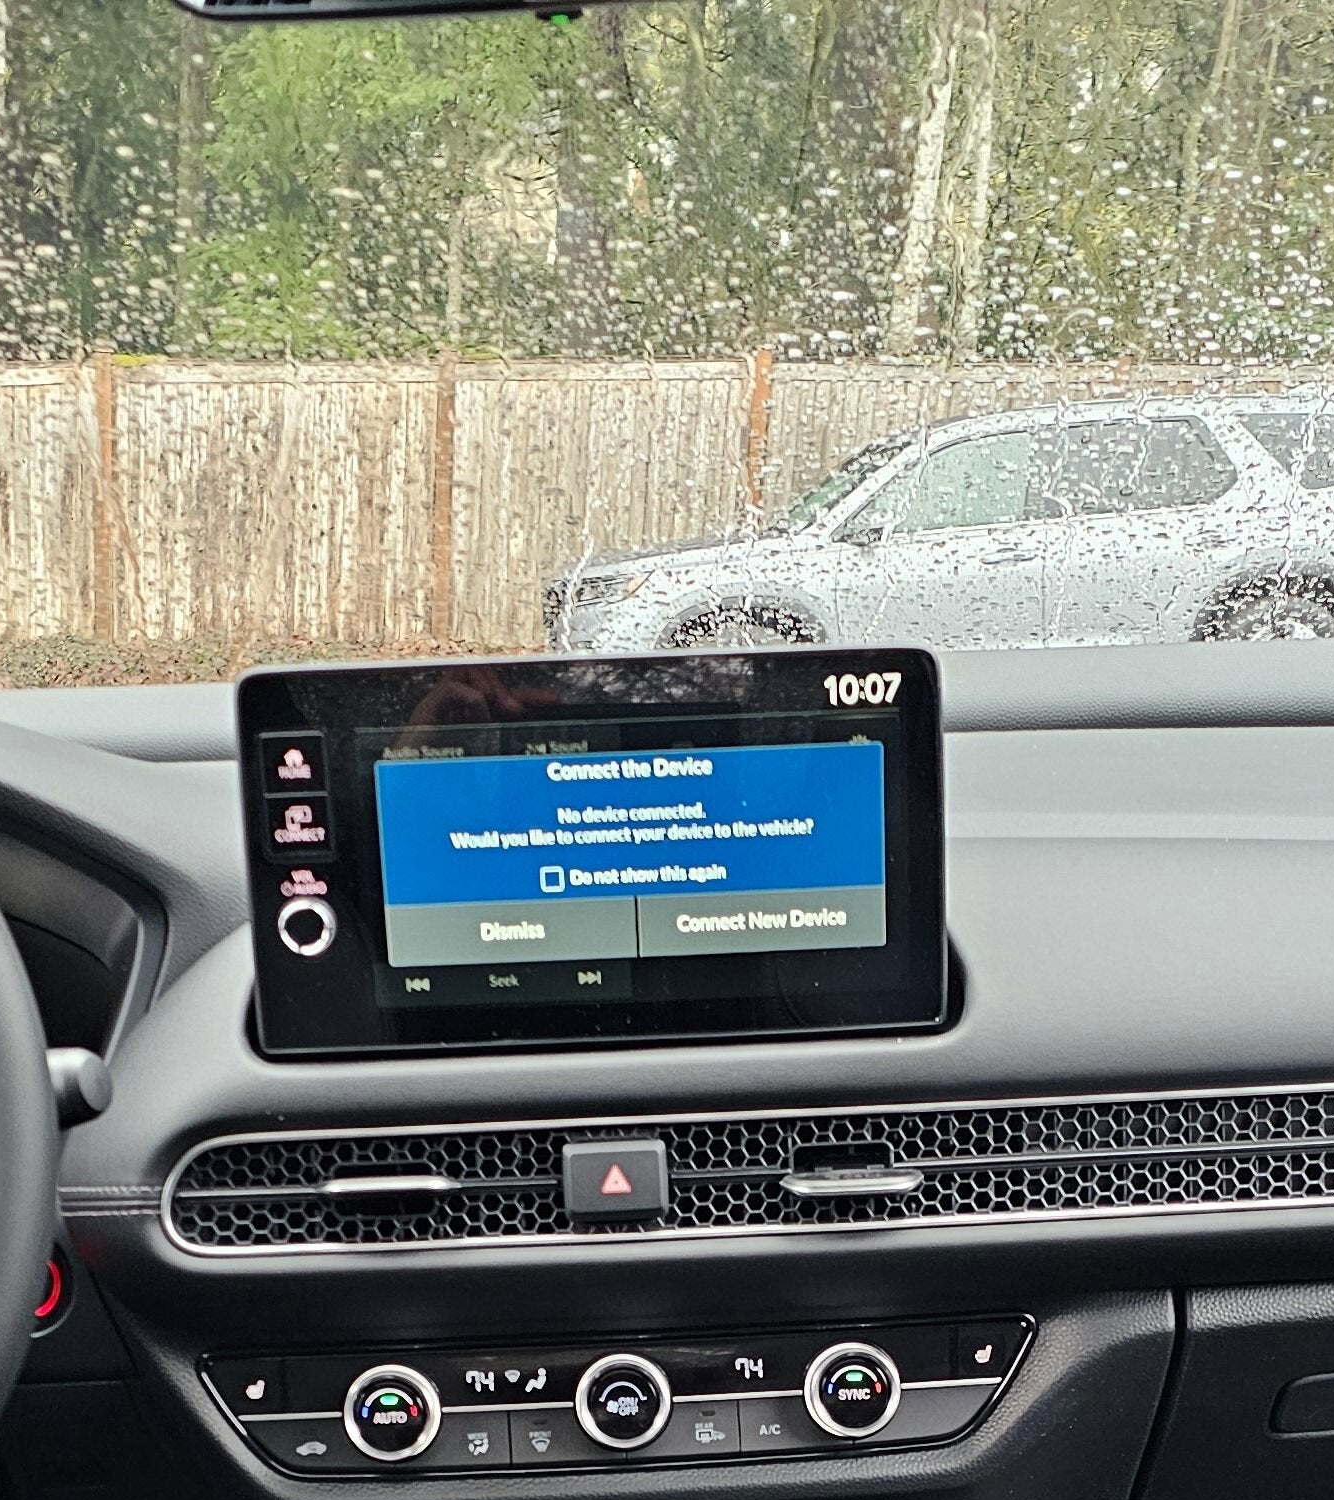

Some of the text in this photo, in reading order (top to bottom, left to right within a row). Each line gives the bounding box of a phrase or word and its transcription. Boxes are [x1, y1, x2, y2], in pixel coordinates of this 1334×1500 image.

[823, 672, 902, 706] 10:07
[547, 757, 713, 781] Connect the Device
[557, 802, 706, 824] No device connected.
[274, 827, 325, 843] CONNECT
[449, 818, 814, 850] Would you like to connect your device to the vehicle?
[570, 864, 727, 886] Do not show this again
[480, 921, 546, 942] Dismiss
[676, 908, 847, 933] Connect New Device
[488, 974, 519, 988] Seek
[734, 1357, 763, 1379] 74
[466, 1369, 495, 1392] 74
[838, 1388, 871, 1401] SYNC
[373, 1411, 408, 1425] AUTO
[618, 1406, 639, 1416] OFF
[759, 1424, 781, 1436] A/C
